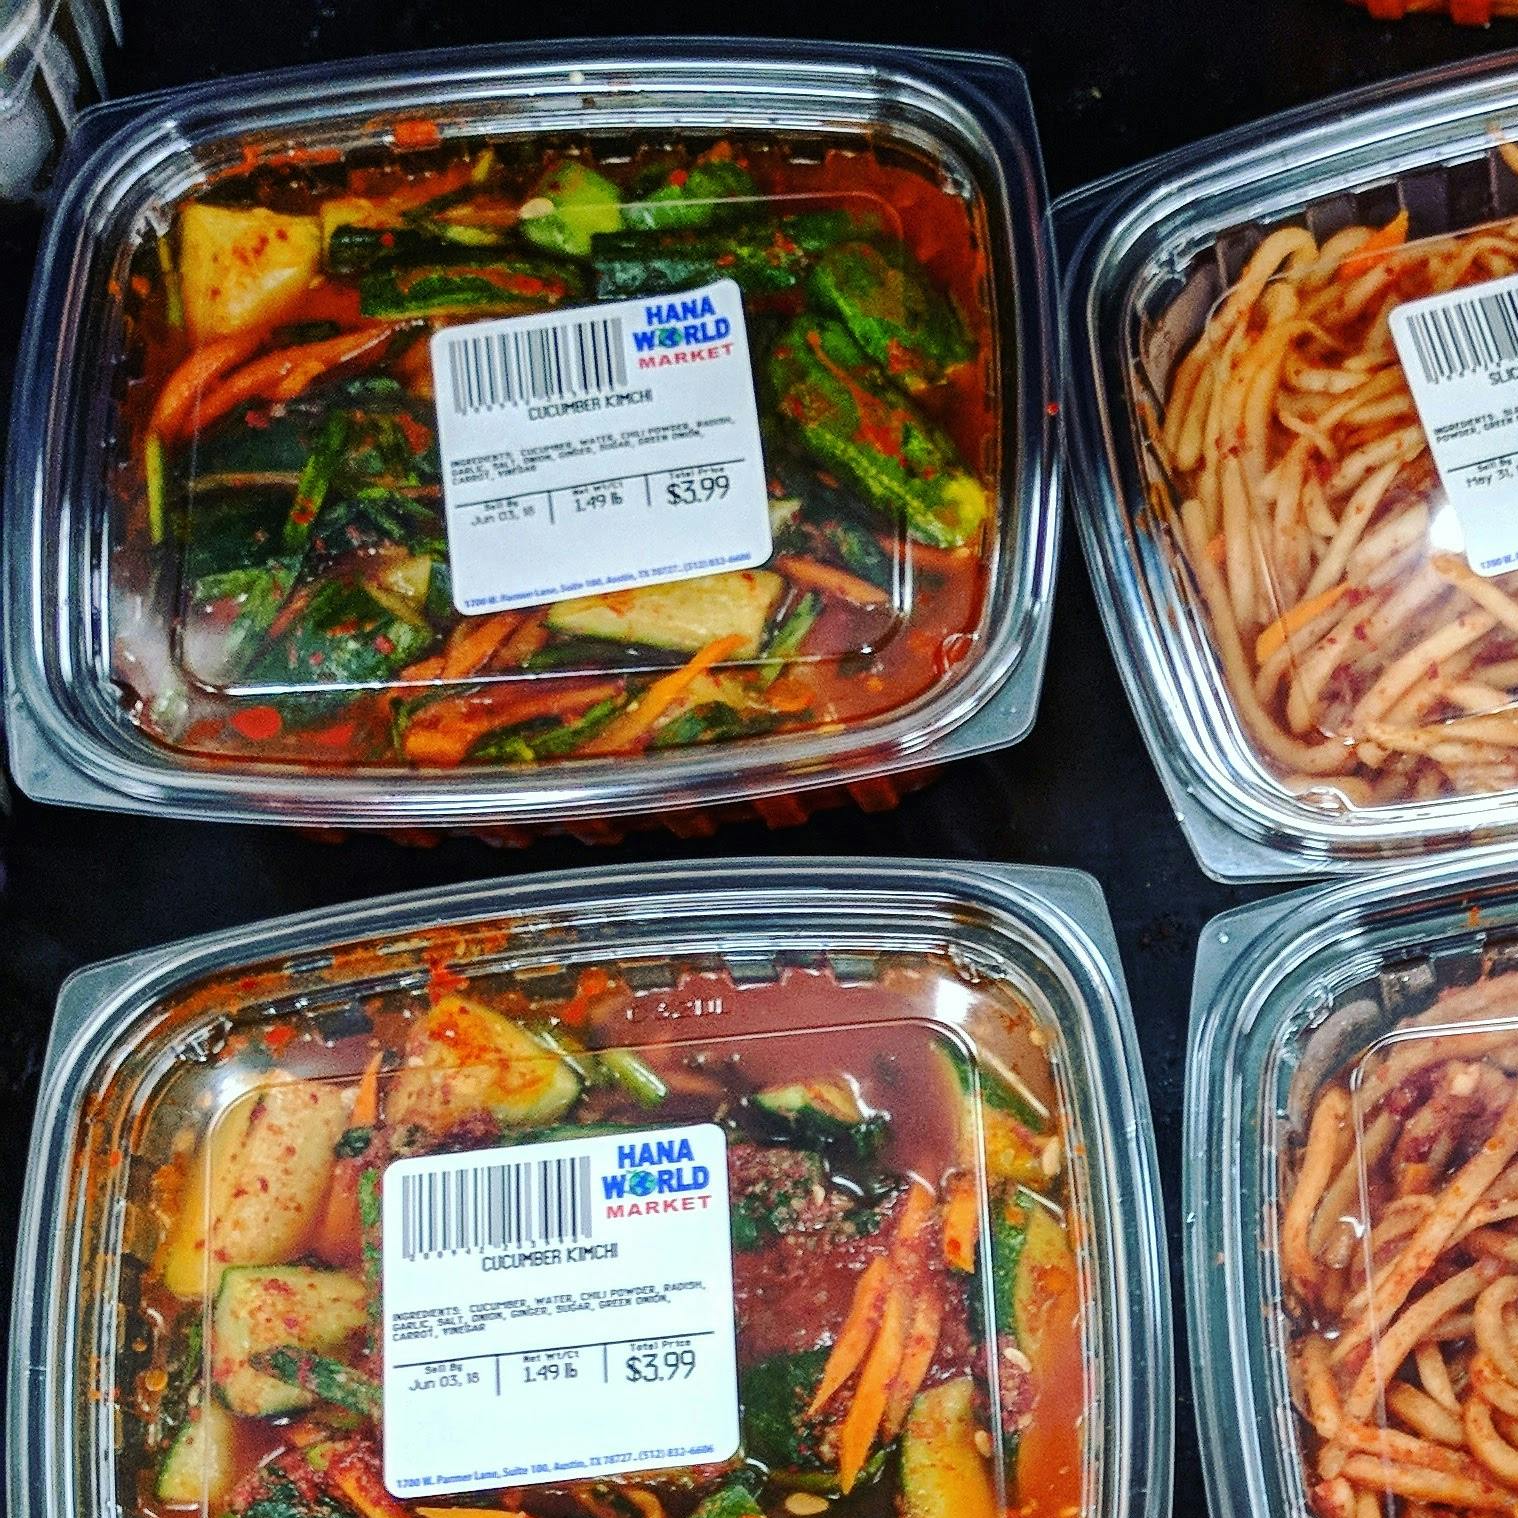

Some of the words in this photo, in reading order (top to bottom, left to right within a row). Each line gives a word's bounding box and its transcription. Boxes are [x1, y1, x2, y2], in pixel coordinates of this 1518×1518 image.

[645, 295, 716, 327] HANA
[632, 316, 731, 352] WORLD
[638, 342, 733, 369] MARKET
[617, 1137, 695, 1169] HANA
[601, 1165, 710, 1200] WORLD
[606, 1194, 712, 1219] MARKET
[481, 1248, 561, 1272] CUCUMBER
[566, 1242, 618, 1263] KIMCHI
[408, 1379, 436, 1392] Jun
[465, 1371, 480, 1384] 18
[523, 1363, 560, 1383] 1.49
[564, 1362, 578, 1378] lb
[625, 1349, 696, 1383] $3.99
